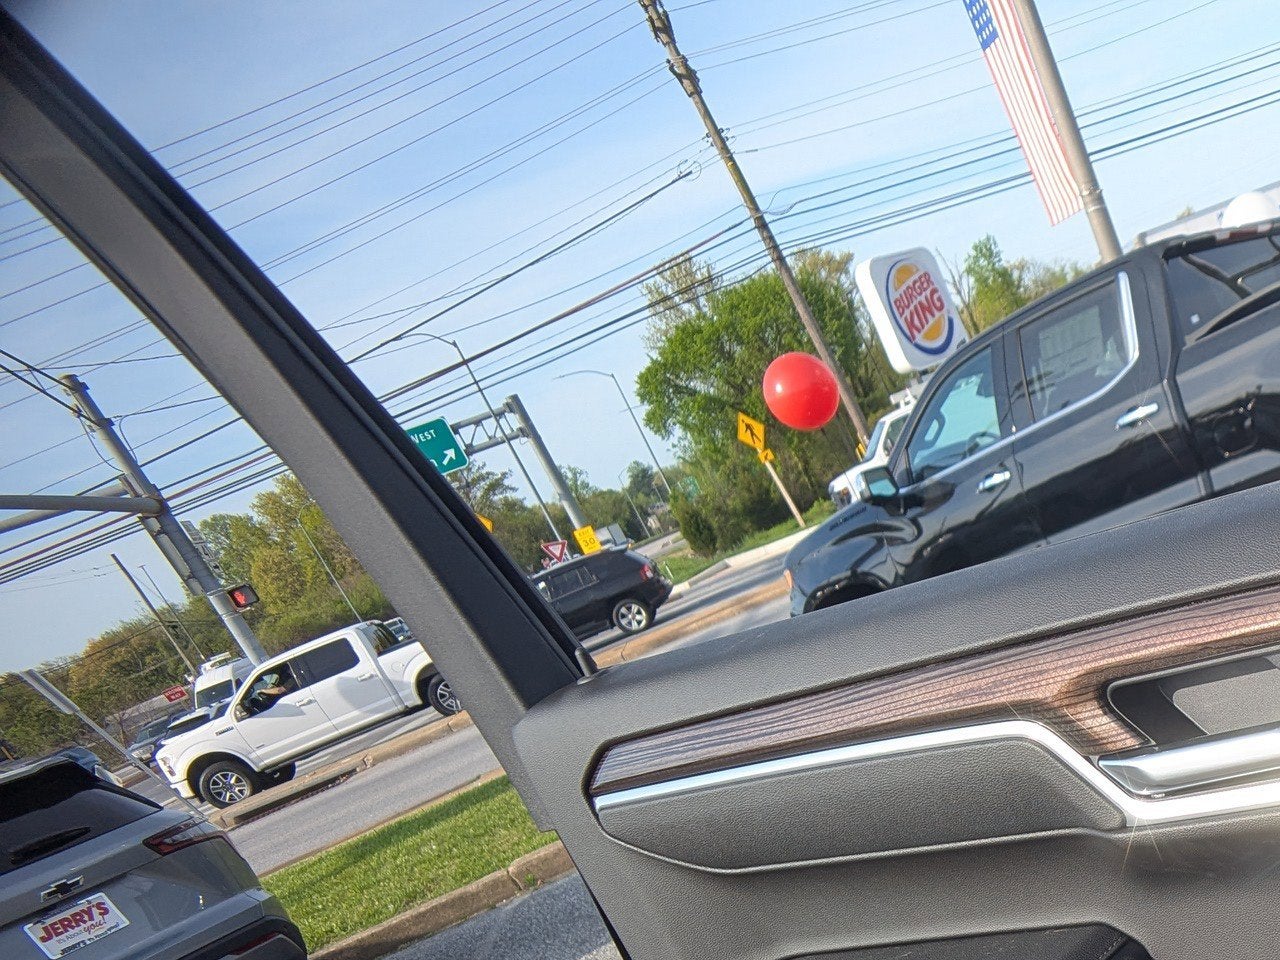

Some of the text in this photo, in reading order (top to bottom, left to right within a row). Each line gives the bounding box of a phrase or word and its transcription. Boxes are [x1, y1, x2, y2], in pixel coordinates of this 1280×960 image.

[893, 270, 935, 318] BURGER
[904, 286, 945, 344] KING
[39, 901, 110, 943] JERRY'S
